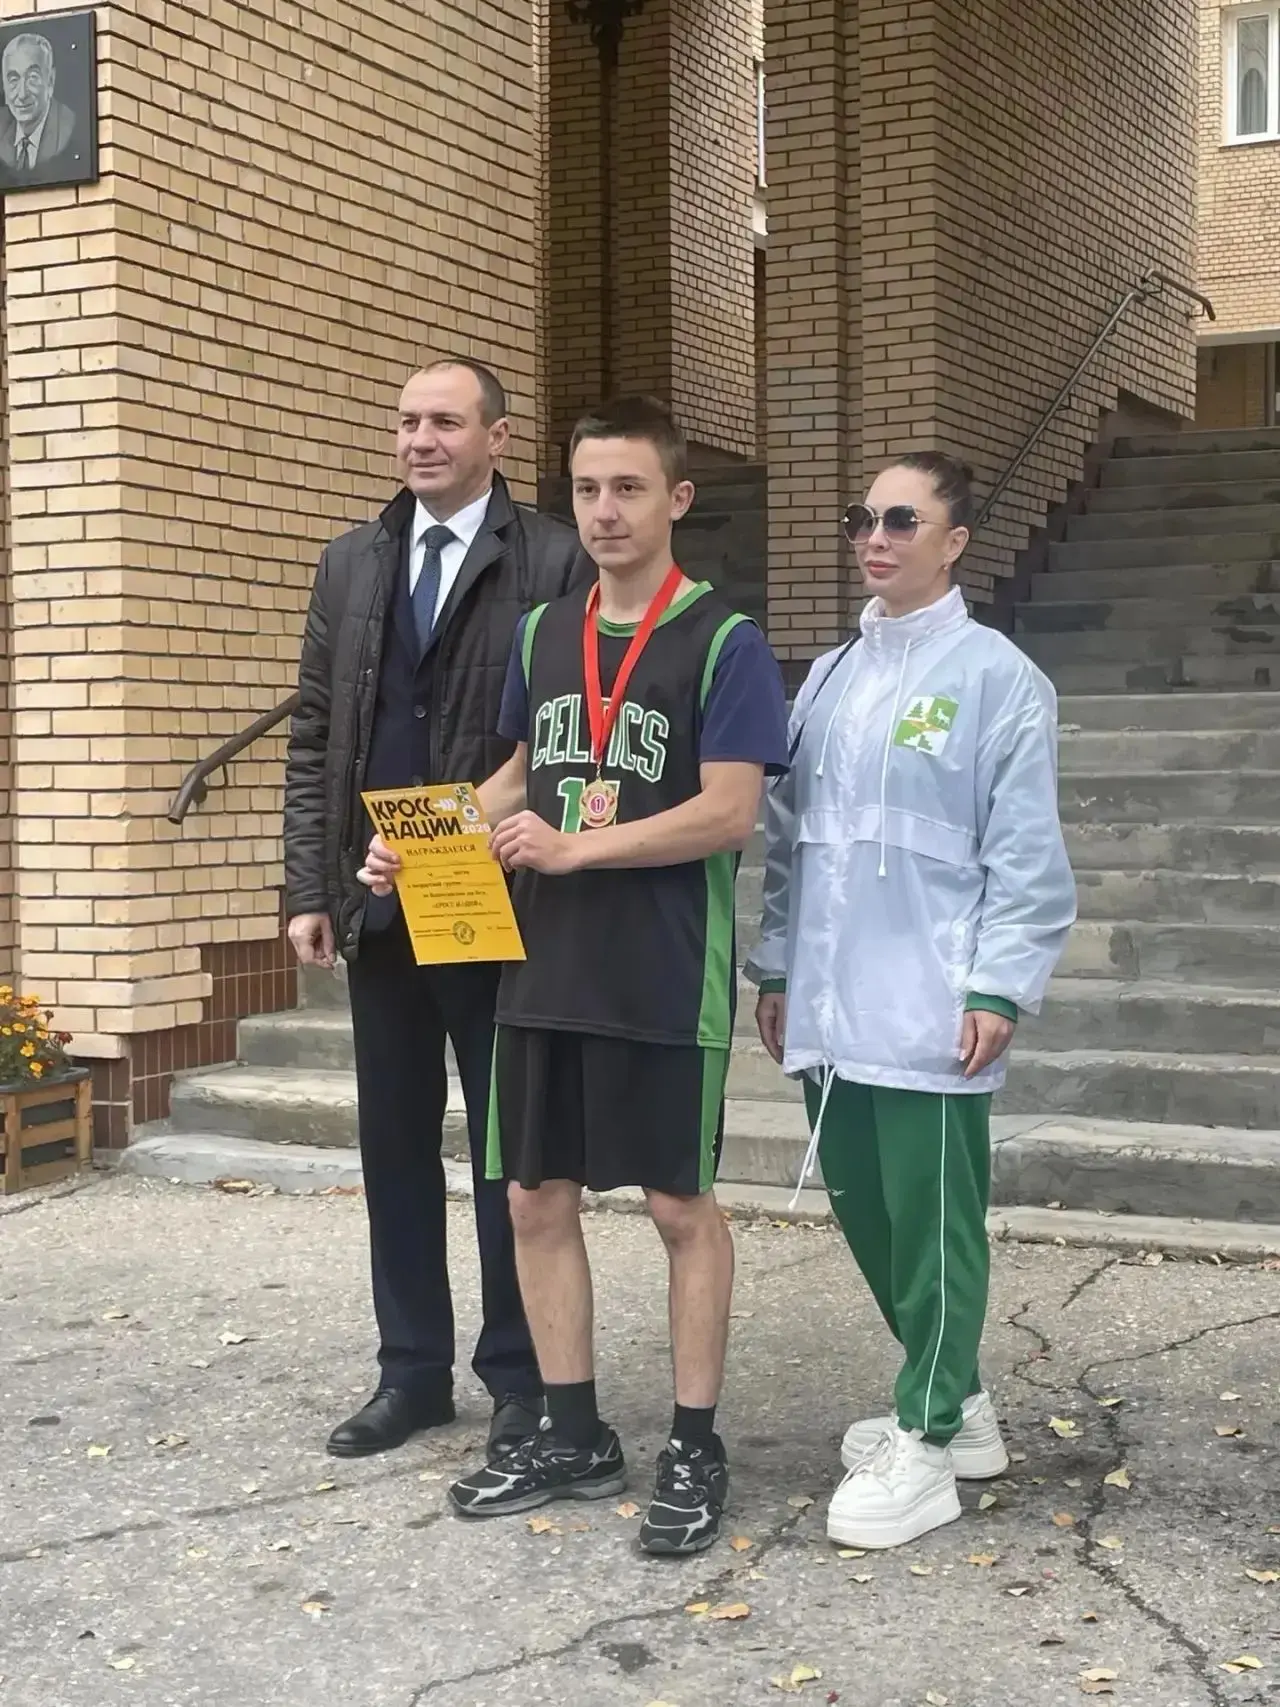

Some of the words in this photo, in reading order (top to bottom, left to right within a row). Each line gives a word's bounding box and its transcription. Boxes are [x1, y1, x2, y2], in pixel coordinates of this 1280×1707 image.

[532, 694, 670, 783] CELICS
[371, 797, 437, 821] КРОСС
[557, 776, 621, 833] 1
[380, 816, 462, 841] НАЦИИ
[461, 823, 491, 834] 2020
